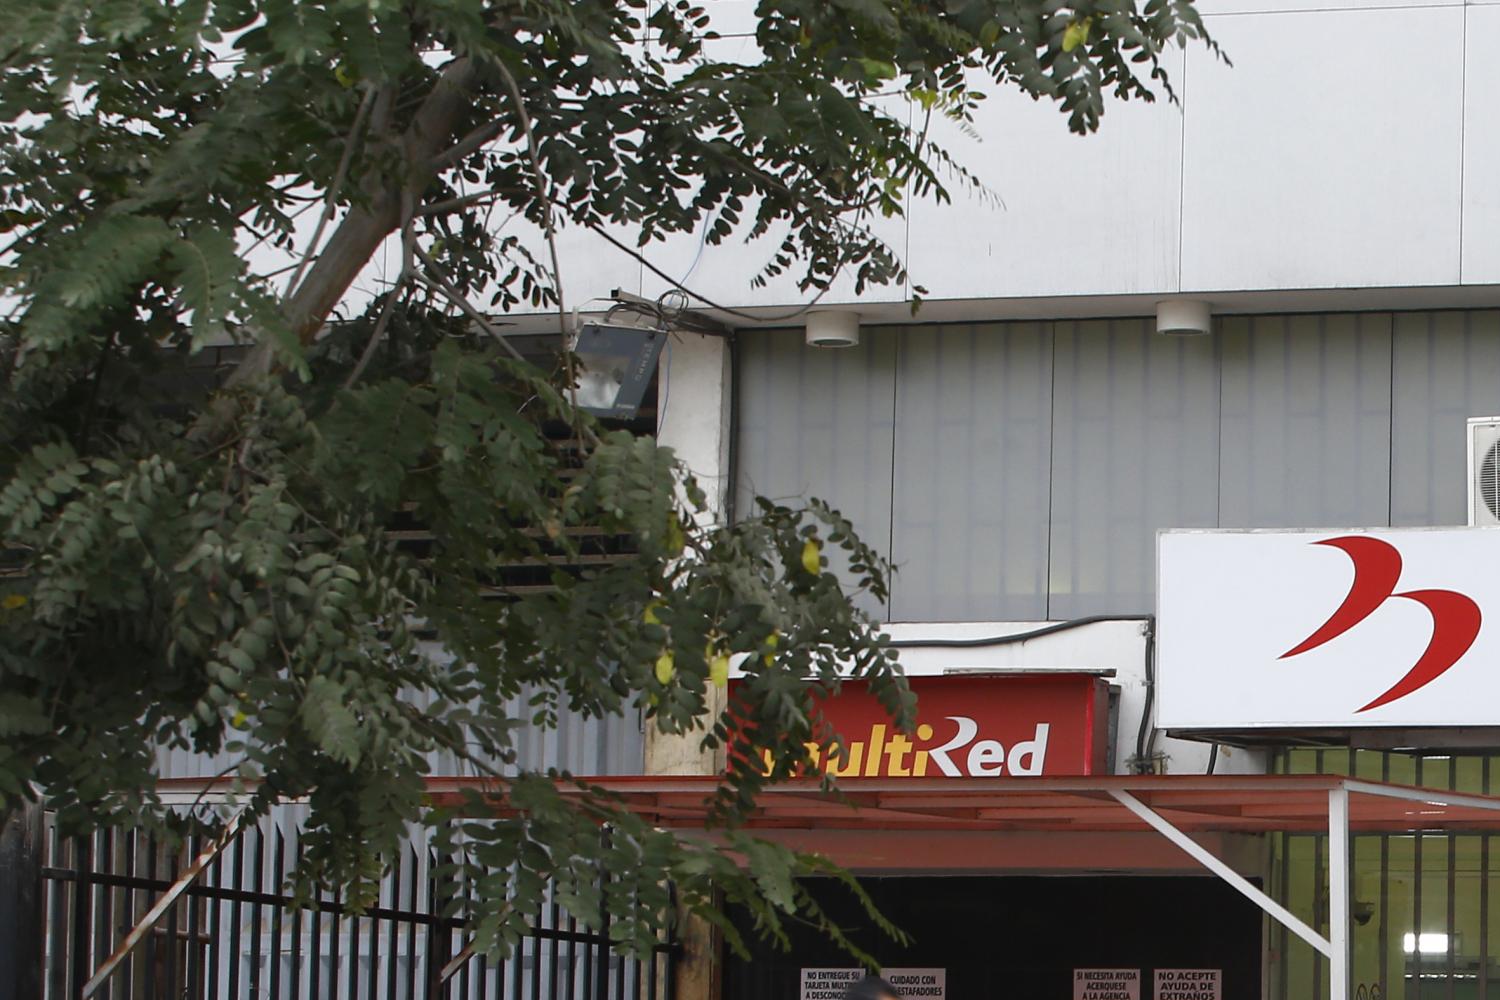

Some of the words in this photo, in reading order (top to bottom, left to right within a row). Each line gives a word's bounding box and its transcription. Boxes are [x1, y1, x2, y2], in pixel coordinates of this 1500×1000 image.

[890, 976, 920, 984] CUIDADO
[921, 976, 936, 984] CON
[1158, 972, 1174, 980] NO
[1176, 972, 1216, 980] ACEPTE
[1086, 982, 1126, 990] ACERQUESE
[1160, 982, 1196, 990] AYUDA
[1200, 982, 1214, 990] DE
[1160, 991, 1215, 1000] EXTRAÑOS
